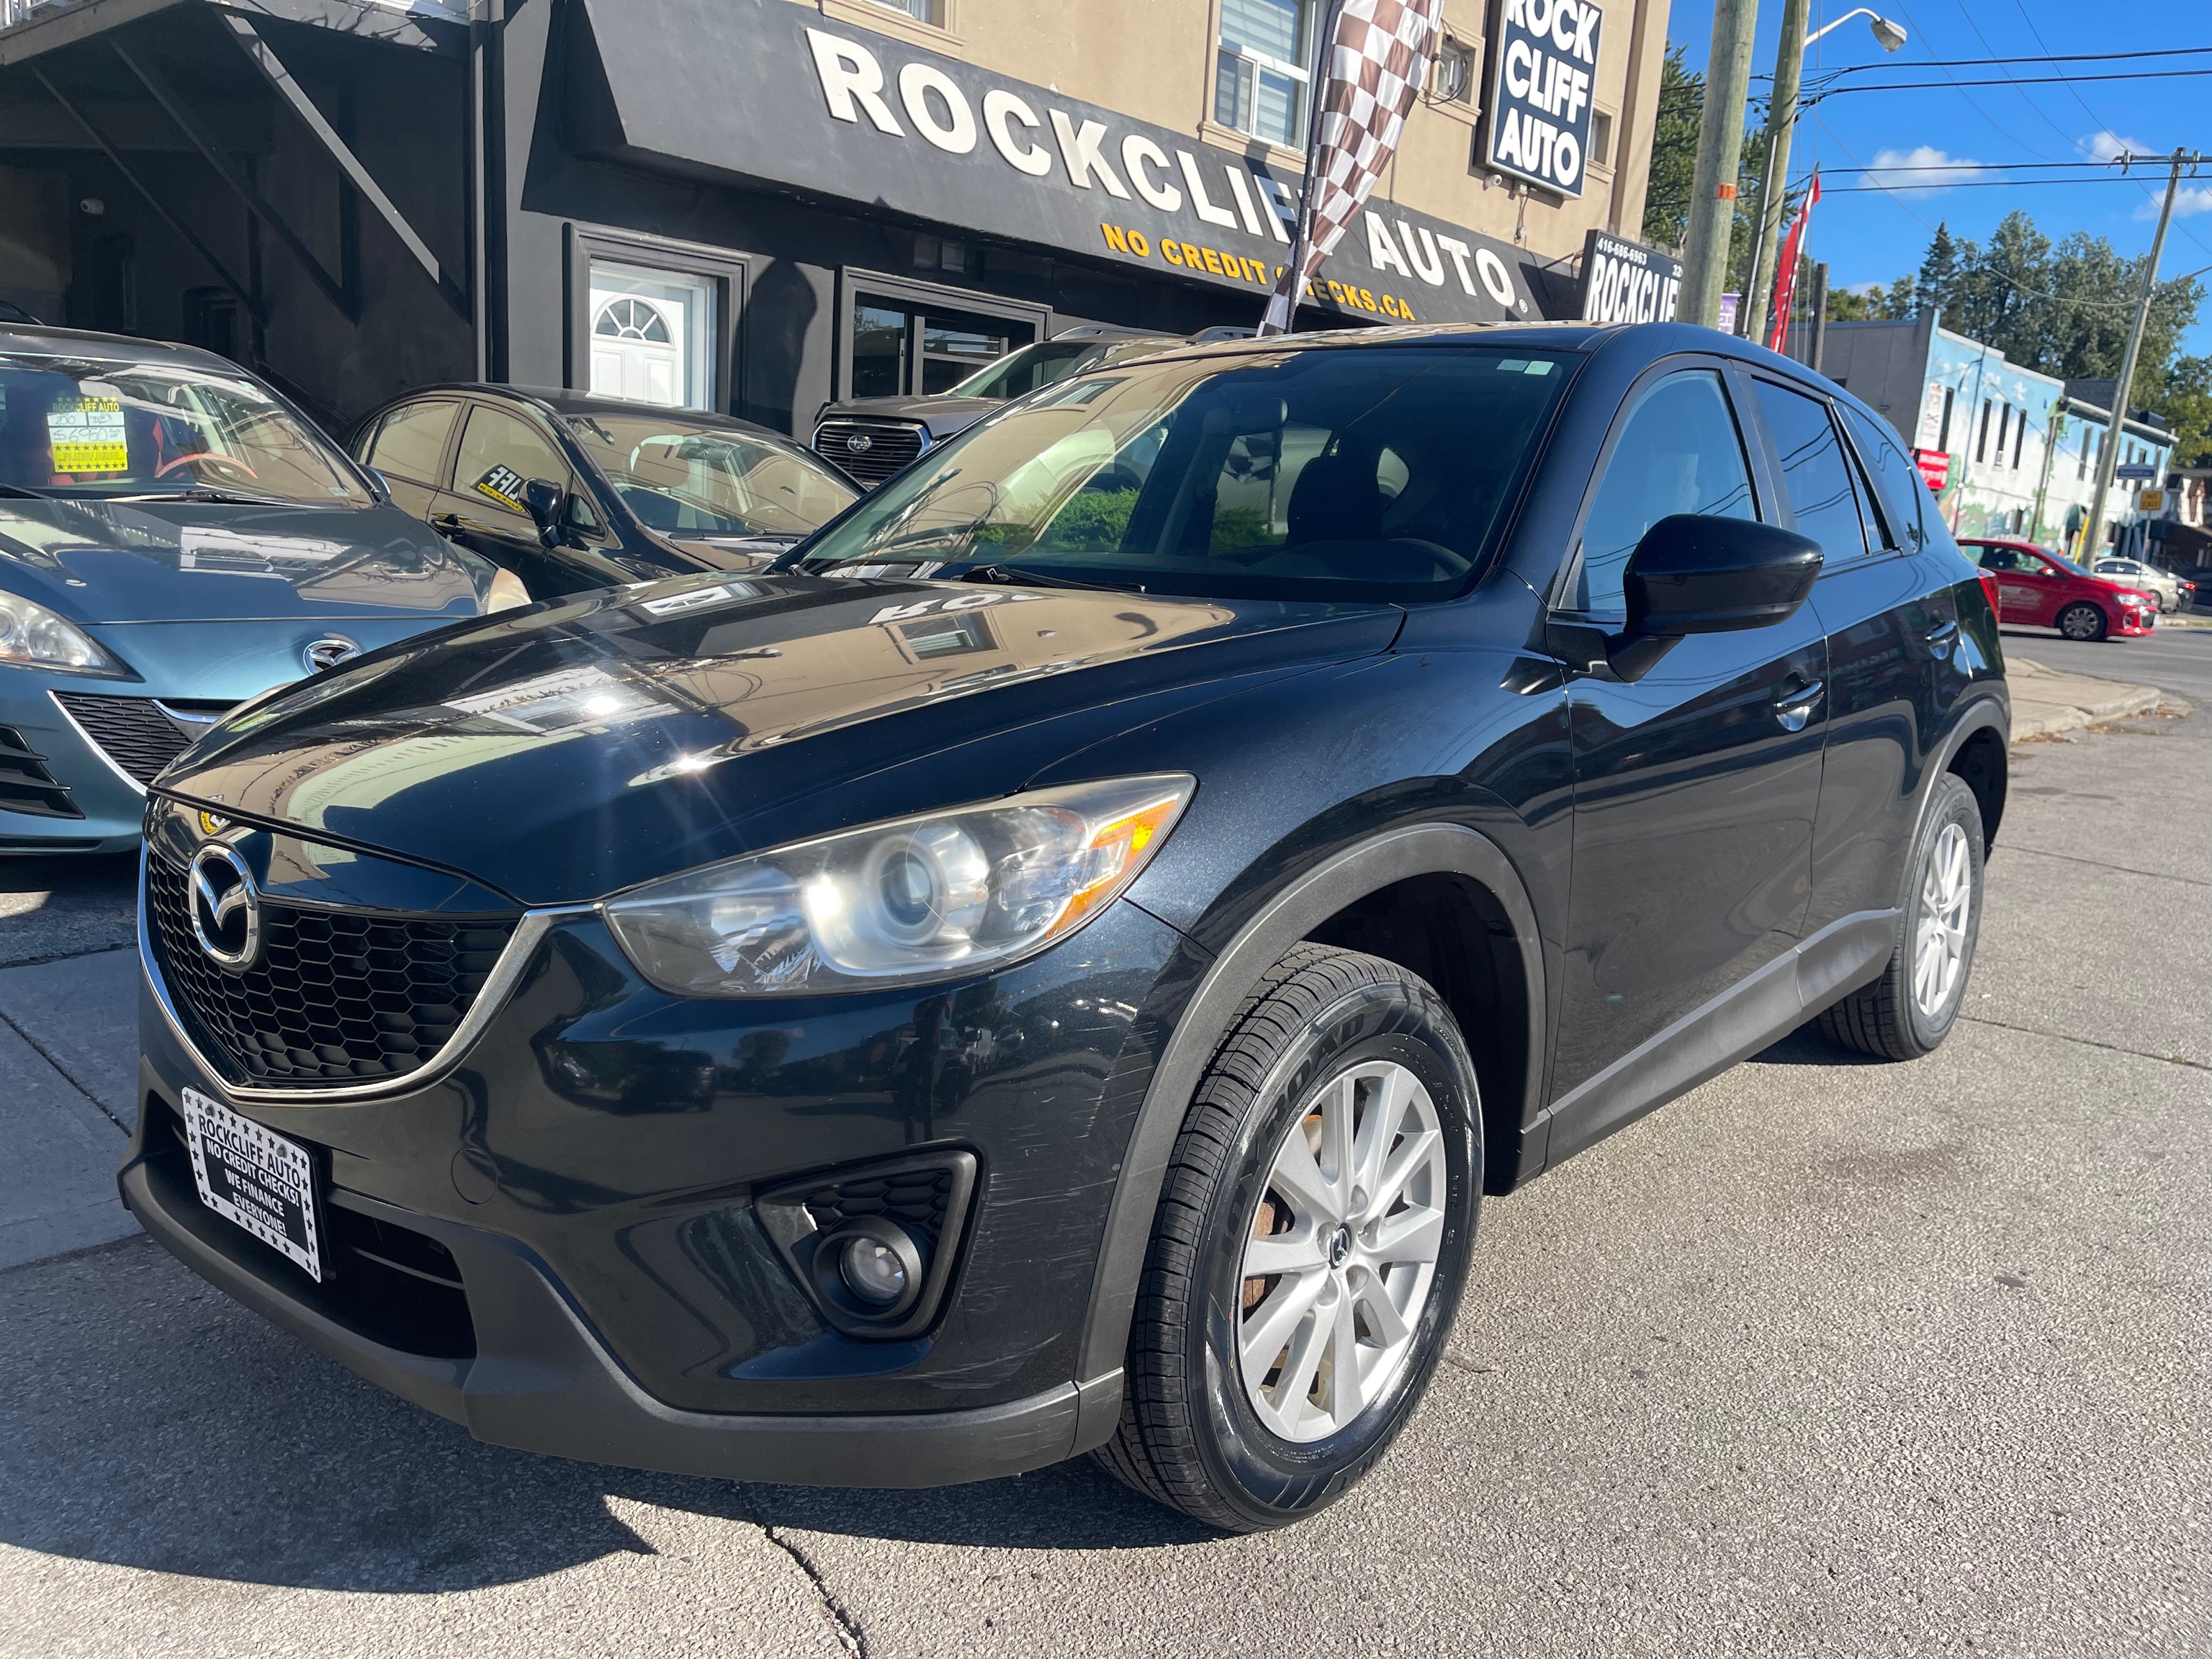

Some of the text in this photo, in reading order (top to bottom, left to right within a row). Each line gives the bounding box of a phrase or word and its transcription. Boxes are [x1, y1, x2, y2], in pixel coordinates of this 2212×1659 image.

[1506, 39, 1589, 125] CLIFF
[806, 27, 1303, 243] ROCKCLIF
[1364, 210, 1516, 307] AUTO
[1496, 107, 1580, 186] AUTO
[1101, 222, 1416, 321] NO CREDIT ECKS.CA
[1585, 253, 1681, 324] ROCKCLIF
[53, 403, 120, 412] ROCKCLIFF AUTO
[198, 1113, 301, 1189] ROCKCLIFF AUTO
[206, 1138, 300, 1208] NO CREDIT CHECKS!
[1220, 1013, 1365, 1277] JOYROAD
[225, 1168, 285, 1218] WE FINANCE
[232, 1191, 288, 1237] EVERYONE!
